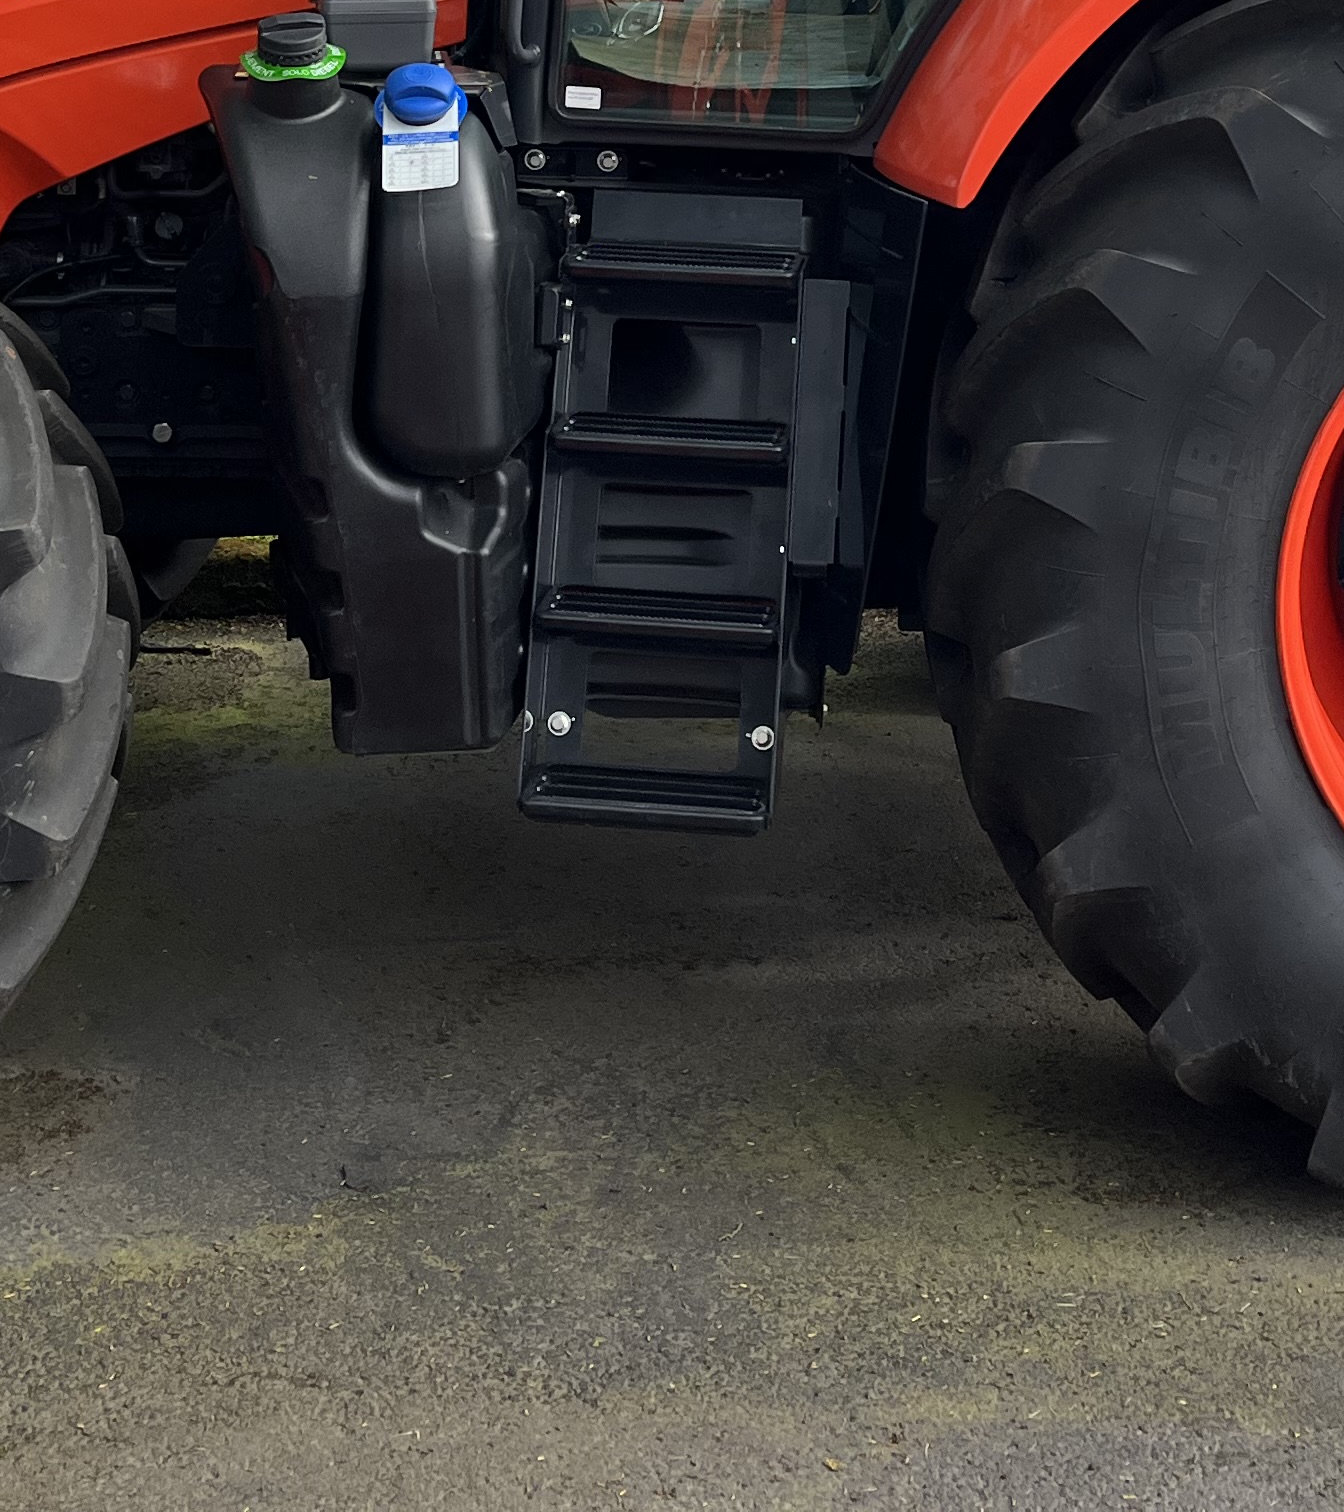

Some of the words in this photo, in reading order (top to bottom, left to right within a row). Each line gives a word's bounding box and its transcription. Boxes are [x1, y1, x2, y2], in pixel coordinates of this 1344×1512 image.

[281, 69, 310, 77] SOLO
[309, 59, 339, 77] DIESEL
[1150, 336, 1276, 779] MULTIBIB
